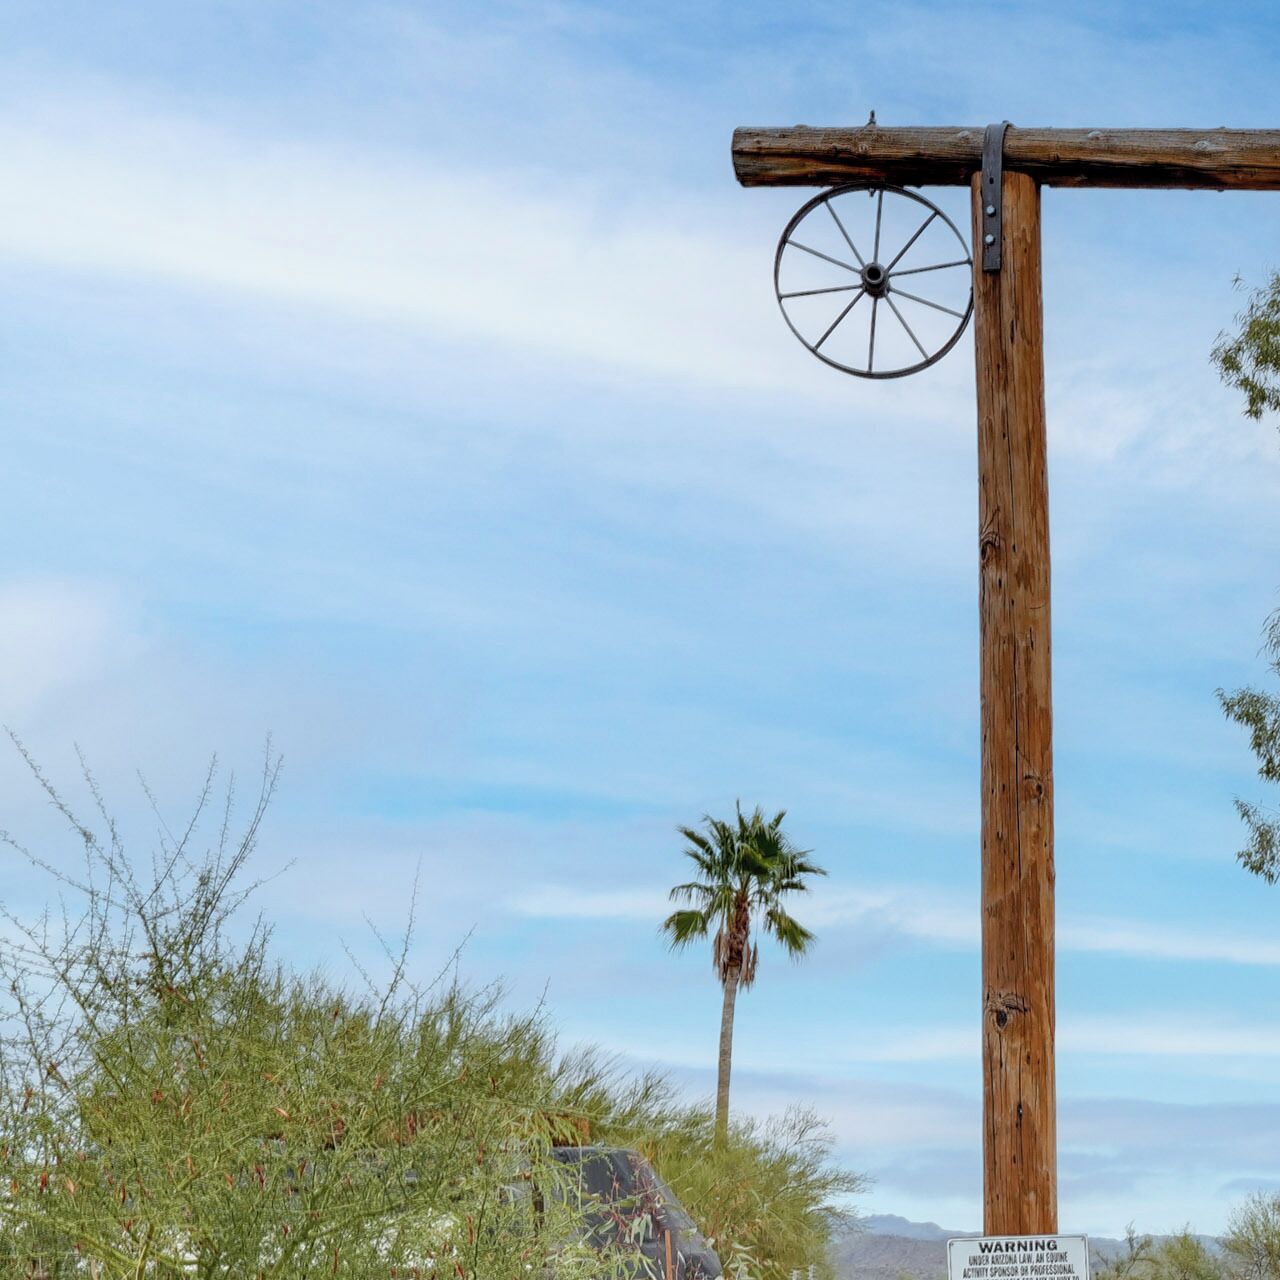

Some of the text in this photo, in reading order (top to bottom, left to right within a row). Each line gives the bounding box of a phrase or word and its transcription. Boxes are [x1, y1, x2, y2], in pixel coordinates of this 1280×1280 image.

[979, 1240, 1058, 1253] WARNING
[969, 1251, 1068, 1266] UNDER ARIZONA LAW, AN EQUINE
[963, 1264, 1075, 1278] ACTIVITY SPONSOR OR PROFESSIONAL
